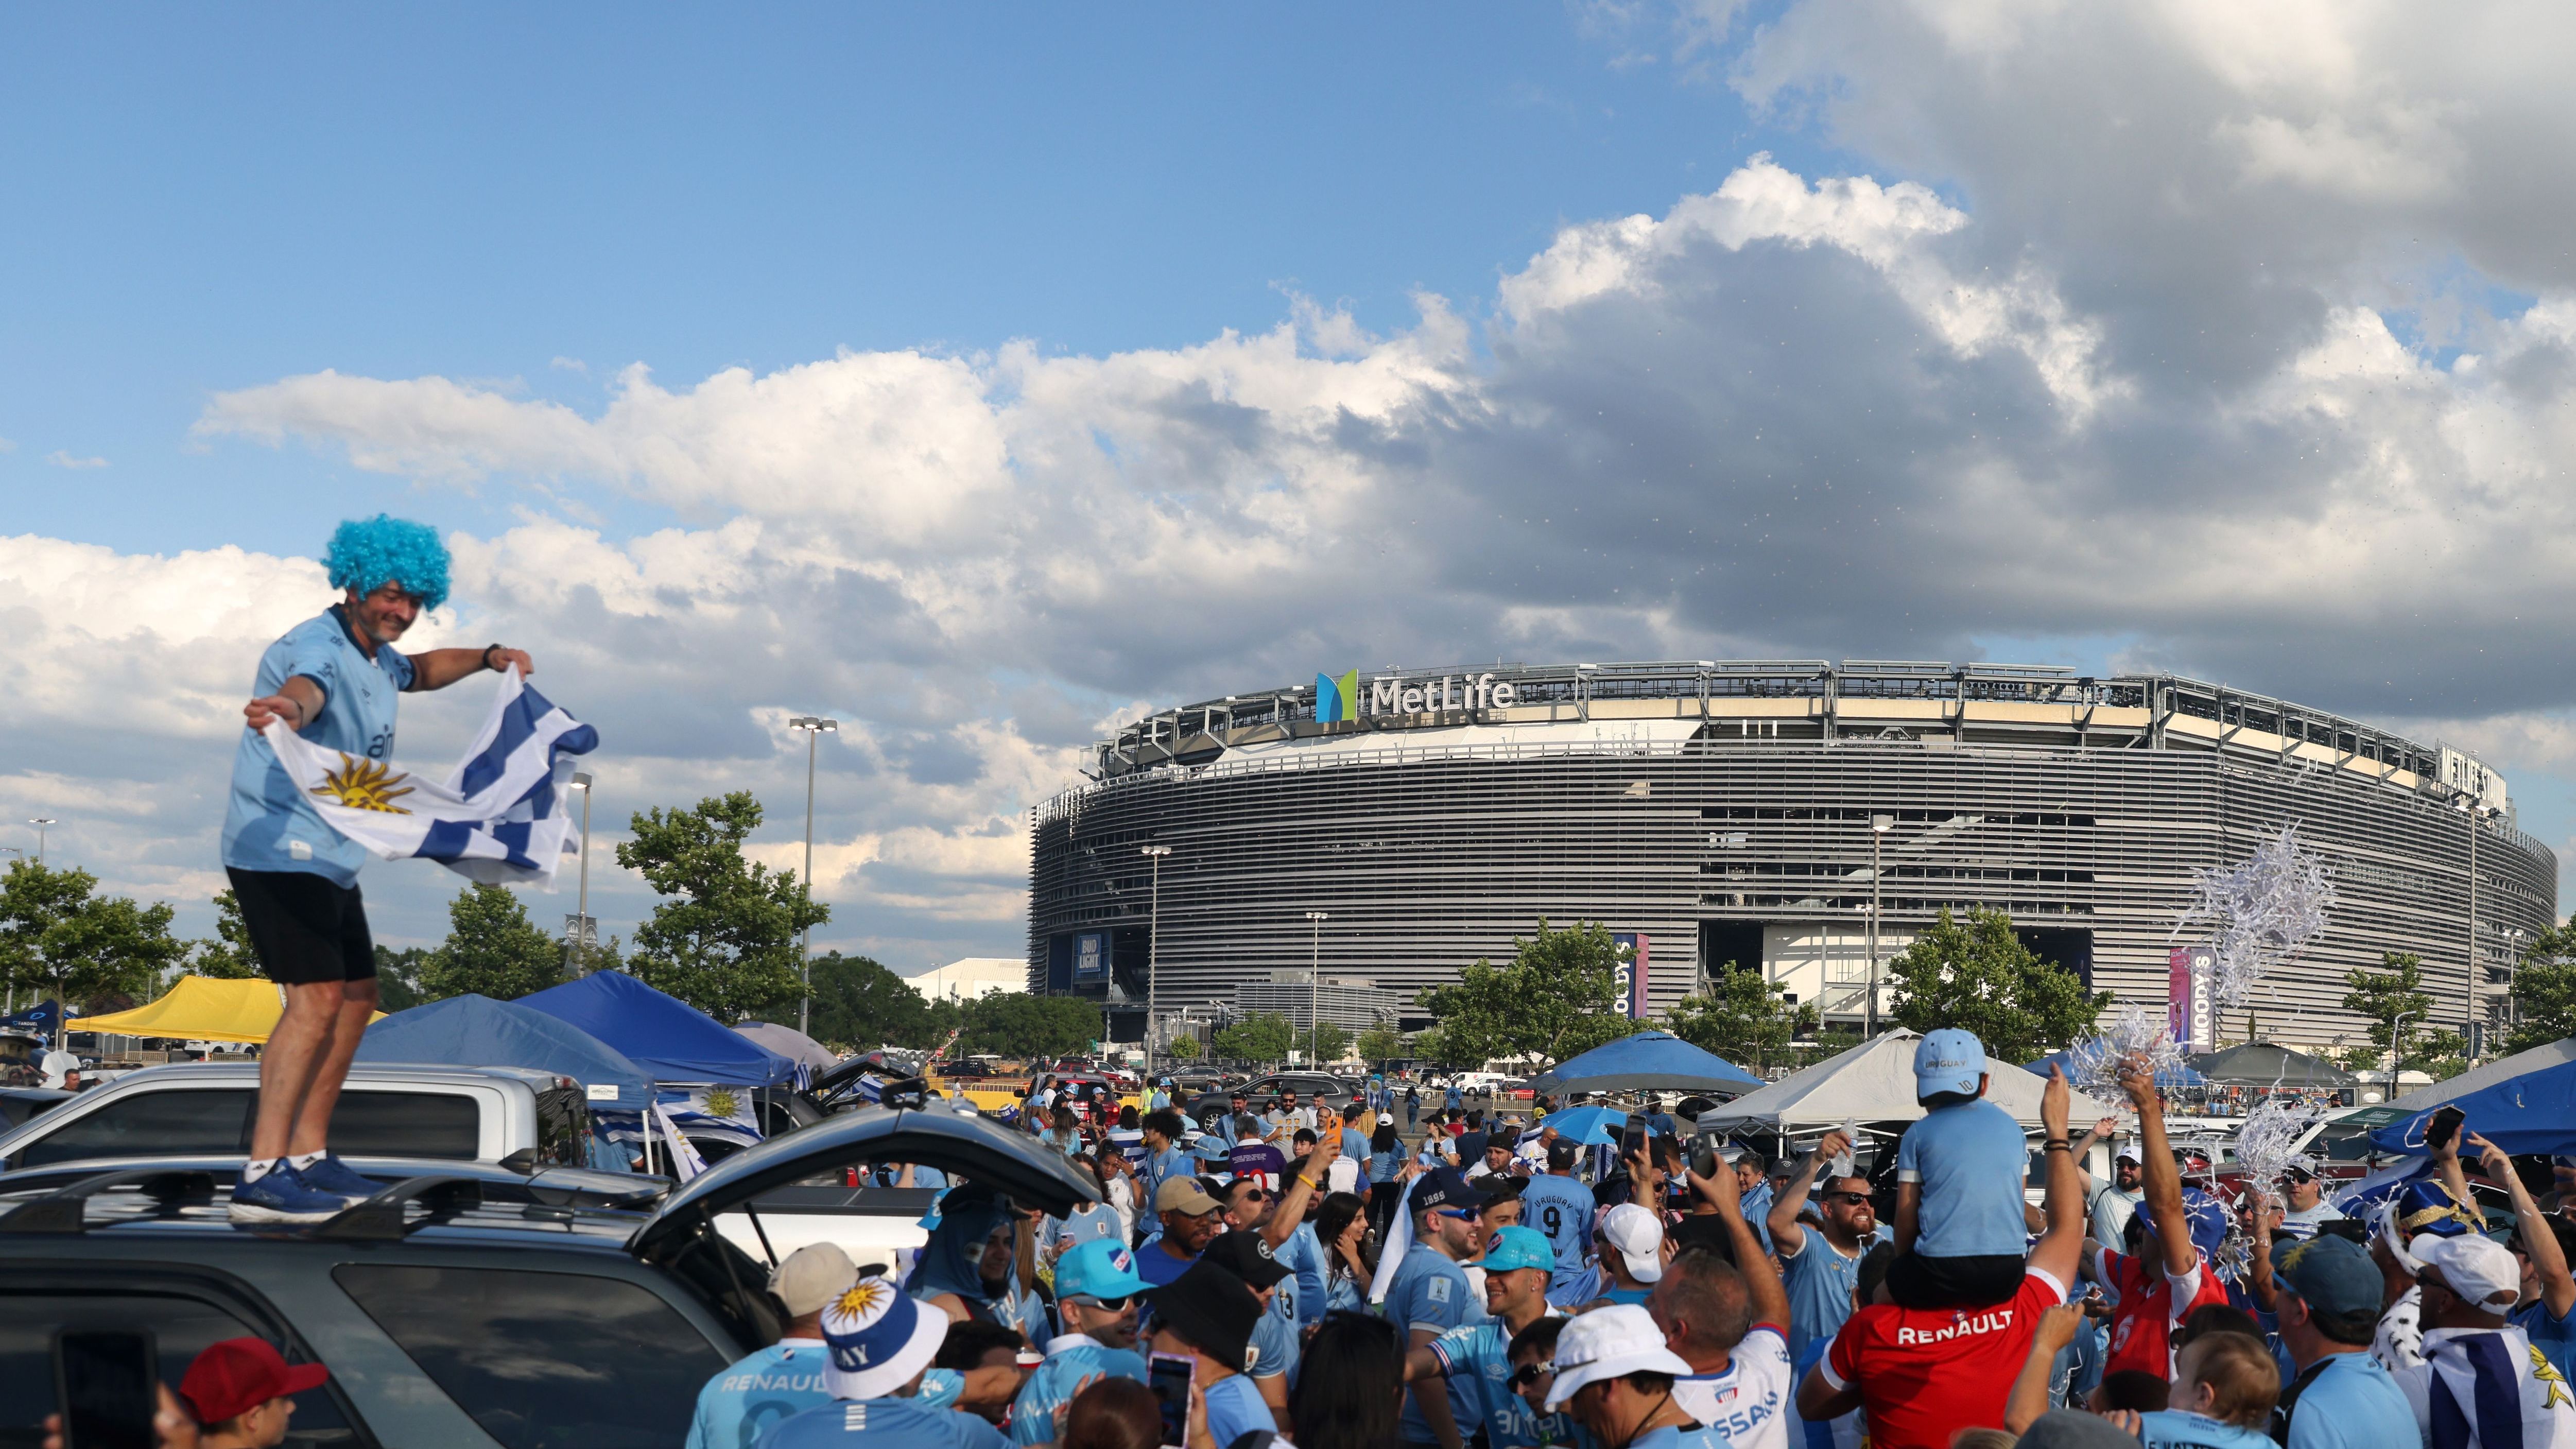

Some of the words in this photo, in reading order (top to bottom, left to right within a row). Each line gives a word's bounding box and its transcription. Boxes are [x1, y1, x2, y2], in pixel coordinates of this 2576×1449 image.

[1371, 672, 1515, 716] MetLife
[2442, 746, 2480, 799] METLIFE
[2482, 766, 2506, 815] STADIUM
[1082, 939, 1097, 954] BUD
[1079, 954, 1099, 969] LIGHT
[2194, 955, 2211, 1046] MOODY'S
[1925, 1060, 1966, 1068] URUGUAY
[1449, 1091, 1456, 1099] 9
[1958, 1080, 1974, 1092] 10
[1422, 1190, 1445, 1206] 1899
[1534, 1195, 1574, 1211] URUGUAY
[1543, 1206, 1562, 1239] 9
[1278, 1292, 1294, 1320] 13
[1898, 1309, 2013, 1345] RENAULT
[2113, 1314, 2135, 1353] 5
